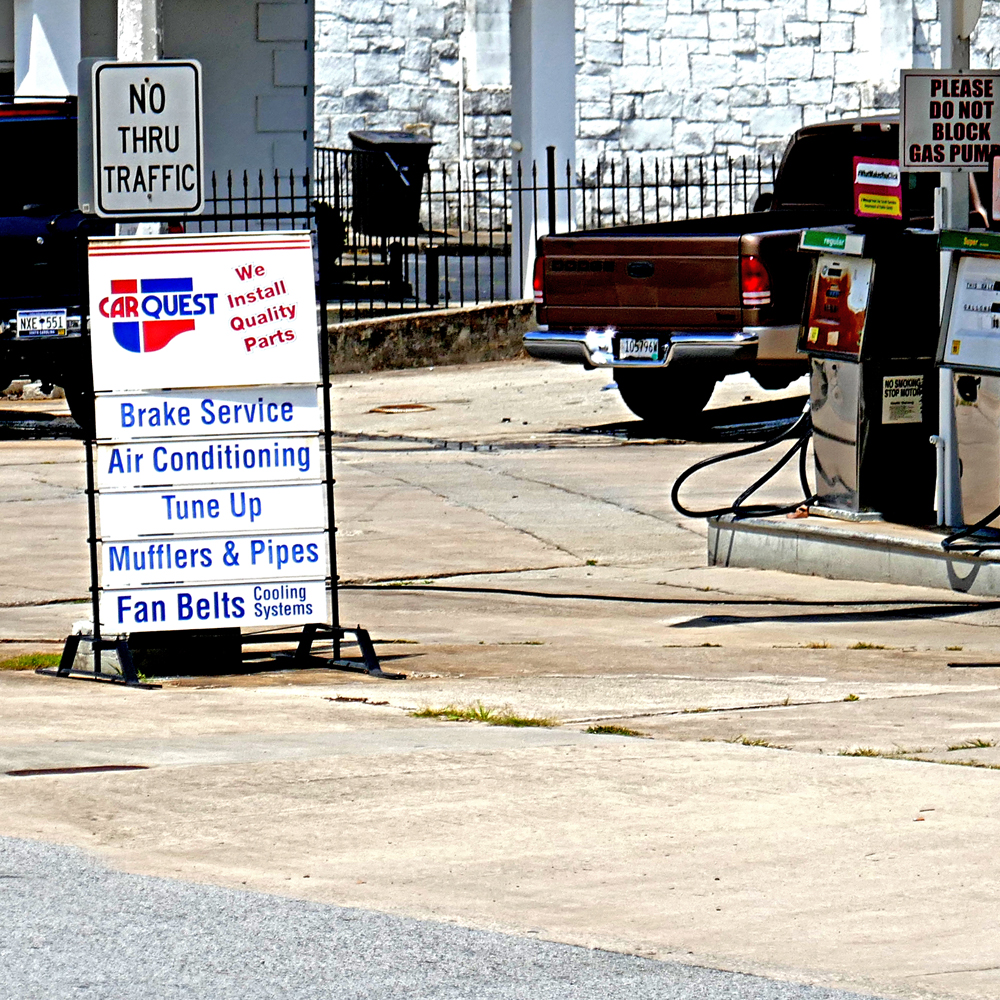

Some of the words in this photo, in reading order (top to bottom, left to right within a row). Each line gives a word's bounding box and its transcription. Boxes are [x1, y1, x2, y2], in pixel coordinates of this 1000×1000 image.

[930, 78, 994, 98] PLEASE
[129, 83, 166, 115] NO
[929, 100, 955, 119] DO
[958, 100, 995, 119] NOT
[117, 125, 180, 154] THRU
[932, 122, 991, 141] BLOCK
[909, 143, 946, 163] GAS
[104, 164, 196, 193] TRAFFIC
[824, 236, 845, 248] regular
[963, 237, 979, 247] Super
[235, 264, 266, 281] We
[227, 280, 287, 309] Install
[20, 317, 38, 330] NXE
[46, 316, 64, 329] 551
[230, 304, 297, 332] Quality
[244, 329, 296, 352] Parts
[884, 379, 893, 388] NO
[884, 389, 900, 398] STOP
[120, 401, 191, 428] Brake
[200, 397, 294, 425] Service
[107, 448, 144, 474] Air
[152, 442, 311, 473] Conditioning
[161, 495, 220, 520] Tune
[230, 491, 262, 523] Up
[108, 543, 213, 572] Mufflers
[222, 540, 240, 567] &
[250, 539, 319, 570] Pipes
[253, 584, 307, 602] Cooling
[117, 595, 166, 624] Fan
[177, 591, 246, 622] Belts
[254, 601, 313, 620] Systems
